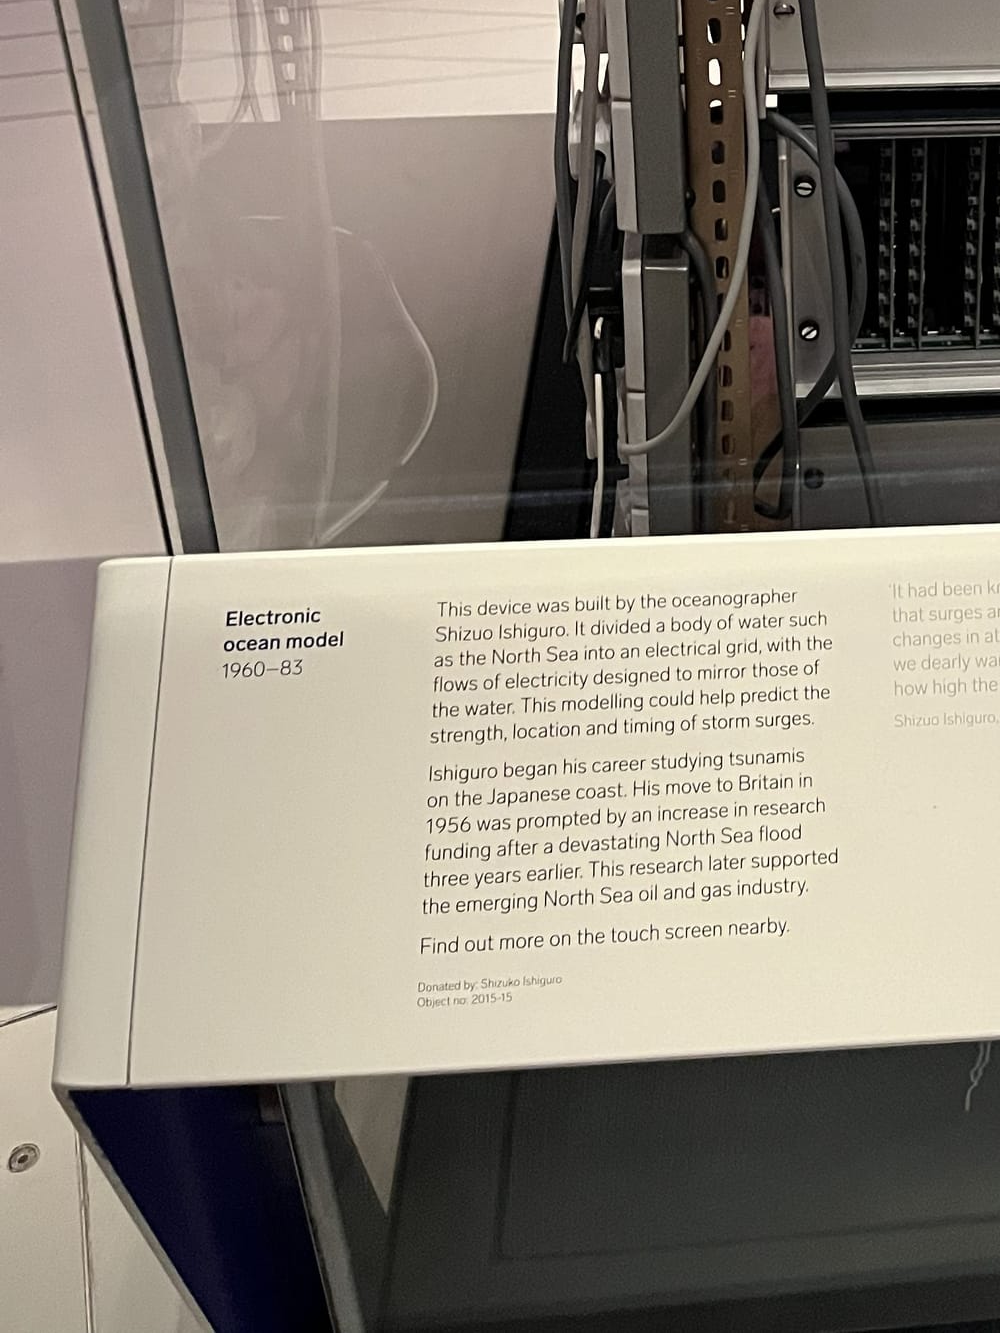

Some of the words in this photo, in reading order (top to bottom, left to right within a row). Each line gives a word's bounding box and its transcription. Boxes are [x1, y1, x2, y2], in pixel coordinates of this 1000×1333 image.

[436, 601, 472, 618] This
[476, 599, 532, 616] device
[536, 600, 570, 614] was
[574, 594, 611, 612] built
[615, 593, 636, 615] by
[640, 593, 667, 610] the
[671, 587, 798, 610] oceanographer
[907, 580, 938, 599] had
[942, 580, 983, 597] been
[225, 606, 322, 628] Electronic
[434, 625, 494, 643] Shizuo
[498, 622, 570, 643] Ishiguro.
[575, 619, 586, 637] It
[590, 617, 651, 636] divided
[655, 620, 666, 634] a
[670, 614, 713, 636] body
[716, 612, 735, 631] of
[738, 613, 785, 630] water
[789, 609, 828, 628] such
[892, 606, 925, 624] that
[928, 607, 983, 625] surges
[223, 637, 281, 653] ocean
[285, 630, 345, 650] model
[433, 654, 454, 668] as
[459, 649, 487, 667] the
[491, 646, 541, 666] North
[545, 645, 579, 663] Sea
[583, 644, 616, 661] into
[620, 646, 640, 660] an
[645, 638, 721, 659] electrical
[725, 636, 763, 659] grid,
[766, 635, 801, 653] with
[806, 634, 833, 652] the
[892, 630, 962, 651] changes
[966, 627, 980, 645] in
[433, 675, 479, 694] flows
[482, 672, 502, 691] of
[505, 670, 589, 691] electricity
[592, 665, 671, 688] designed
[676, 666, 693, 682] to
[697, 663, 748, 681] mirror
[752, 660, 799, 679] those
[802, 658, 821, 676] of
[893, 658, 917, 672] we
[920, 652, 971, 674] dearly
[432, 700, 460, 719] the
[464, 700, 516, 717] water.
[520, 696, 557, 714] This
[561, 692, 644, 713] modelling
[648, 689, 695, 708] could
[699, 687, 736, 709] help
[740, 685, 799, 707] predict
[803, 683, 831, 701] the
[893, 679, 929, 697] how
[932, 676, 968, 697] high
[972, 675, 999, 694] the
[429, 723, 508, 746] strength,
[512, 721, 581, 740] location
[585, 717, 618, 737] and
[623, 716, 676, 737] timing
[679, 713, 698, 732] of
[701, 714, 751, 731] storm
[755, 713, 815, 731] surges.
[893, 713, 940, 728] Shizuo
[943, 710, 1000, 728] Ishiguro,
[426, 794, 449, 809] on
[454, 789, 483, 808] the
[486, 787, 571, 809] Japanese
[575, 781, 628, 800] coast.
[632, 779, 661, 798] His
[665, 780, 712, 797] move
[716, 776, 734, 793] to
[738, 773, 794, 792] Britain
[798, 775, 813, 789] in
[425, 815, 472, 835] 1956
[476, 817, 512, 832] was
[516, 807, 601, 835] prompted
[606, 806, 628, 829] by
[631, 809, 652, 824] an
[657, 804, 729, 822] increase
[733, 801, 748, 818] in
[753, 795, 826, 817] research
[423, 869, 470, 888] three
[474, 869, 522, 890] years
[526, 862, 584, 883] earlier.
[587, 859, 625, 879] This
[629, 854, 703, 877] research
[708, 853, 747, 872] later
[751, 846, 839, 872] supported
[422, 897, 451, 915] the
[455, 892, 538, 915] emerging
[543, 887, 595, 909] North
[599, 885, 634, 905] Sea
[638, 883, 658, 902] oil
[663, 881, 696, 901] and
[700, 884, 732, 903] gas
[736, 877, 809, 898] industry.
[420, 934, 460, 955] Find
[464, 934, 495, 953] out
[499, 935, 545, 951] more
[549, 933, 572, 948] on
[577, 927, 606, 946] the
[611, 923, 660, 944] touch
[664, 924, 723, 940] screen
[728, 915, 790, 938] nearby.
[417, 979, 462, 994] Donated
[480, 977, 521, 990] Shizuko
[522, 975, 563, 988] Ishiguro
[416, 996, 451, 1010] Object
[470, 991, 513, 1006] 2015-15
